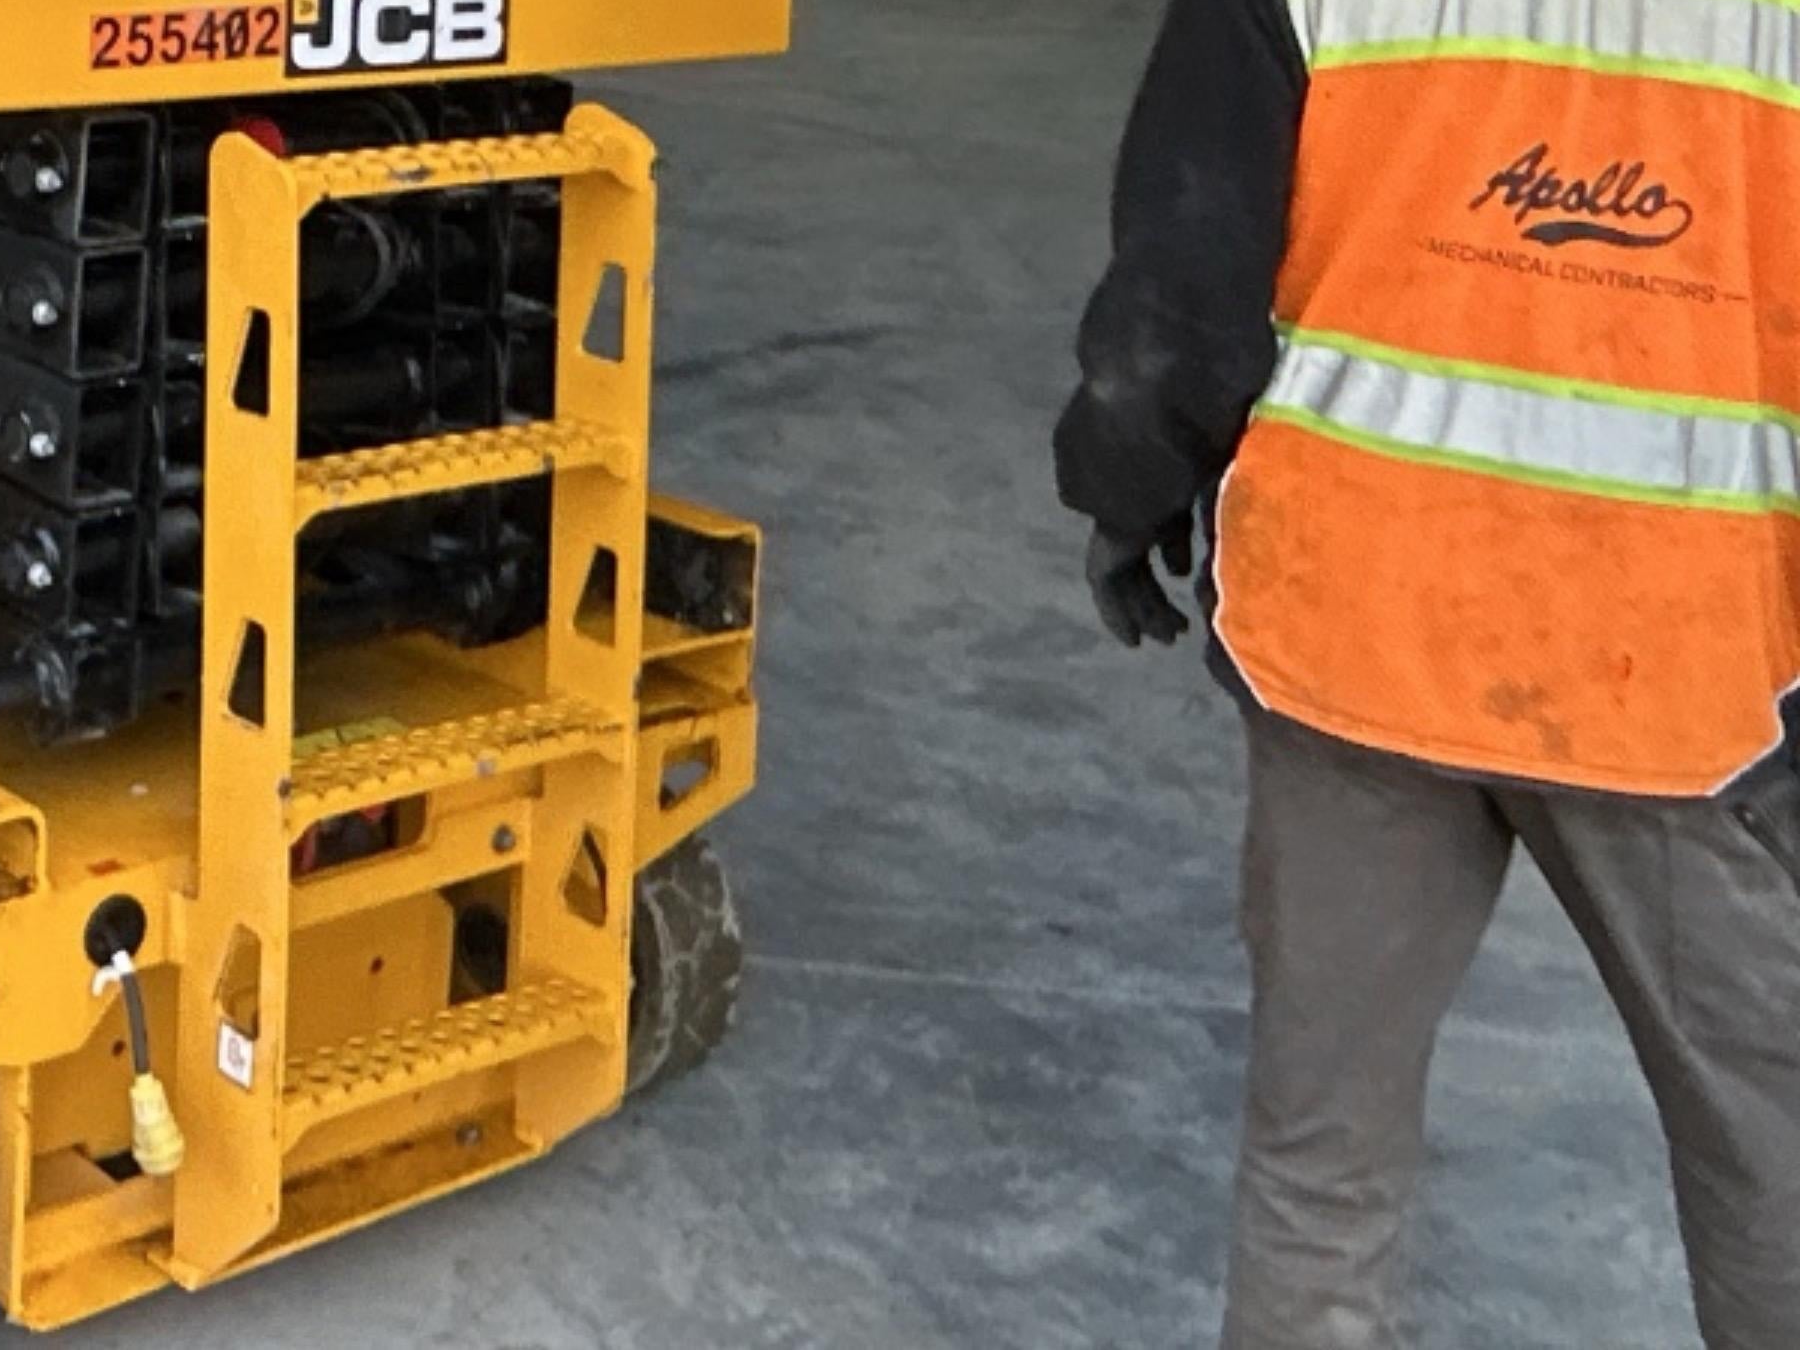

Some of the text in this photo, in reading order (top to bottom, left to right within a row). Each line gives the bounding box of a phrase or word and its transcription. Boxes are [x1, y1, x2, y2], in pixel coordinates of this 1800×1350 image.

[92, 5, 281, 69] 255402
[1469, 142, 1693, 248] Apollo
[1426, 236, 1717, 303] MECHANICAL CONTRACTORS
